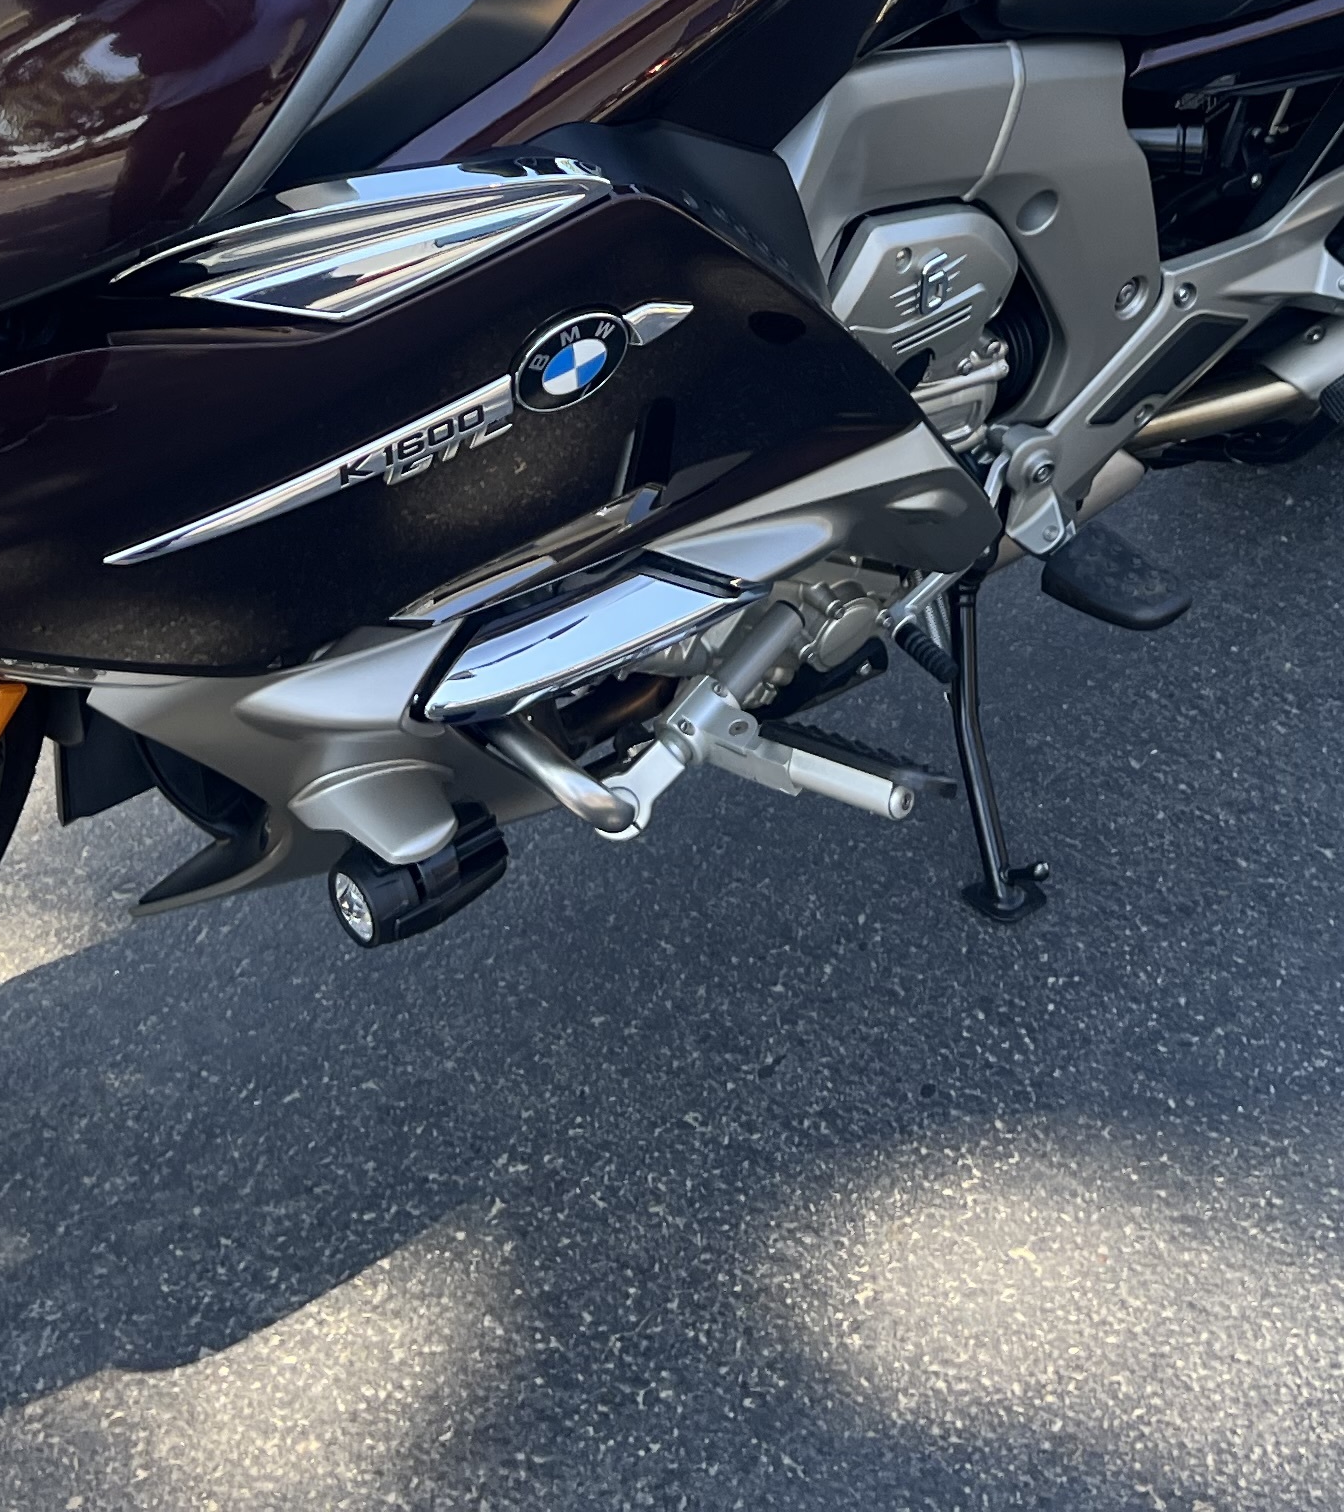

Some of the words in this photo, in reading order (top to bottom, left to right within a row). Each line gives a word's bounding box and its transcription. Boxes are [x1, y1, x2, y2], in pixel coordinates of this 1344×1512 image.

[528, 320, 616, 371] BMW
[340, 455, 373, 486] K
[384, 405, 485, 465] 1600
